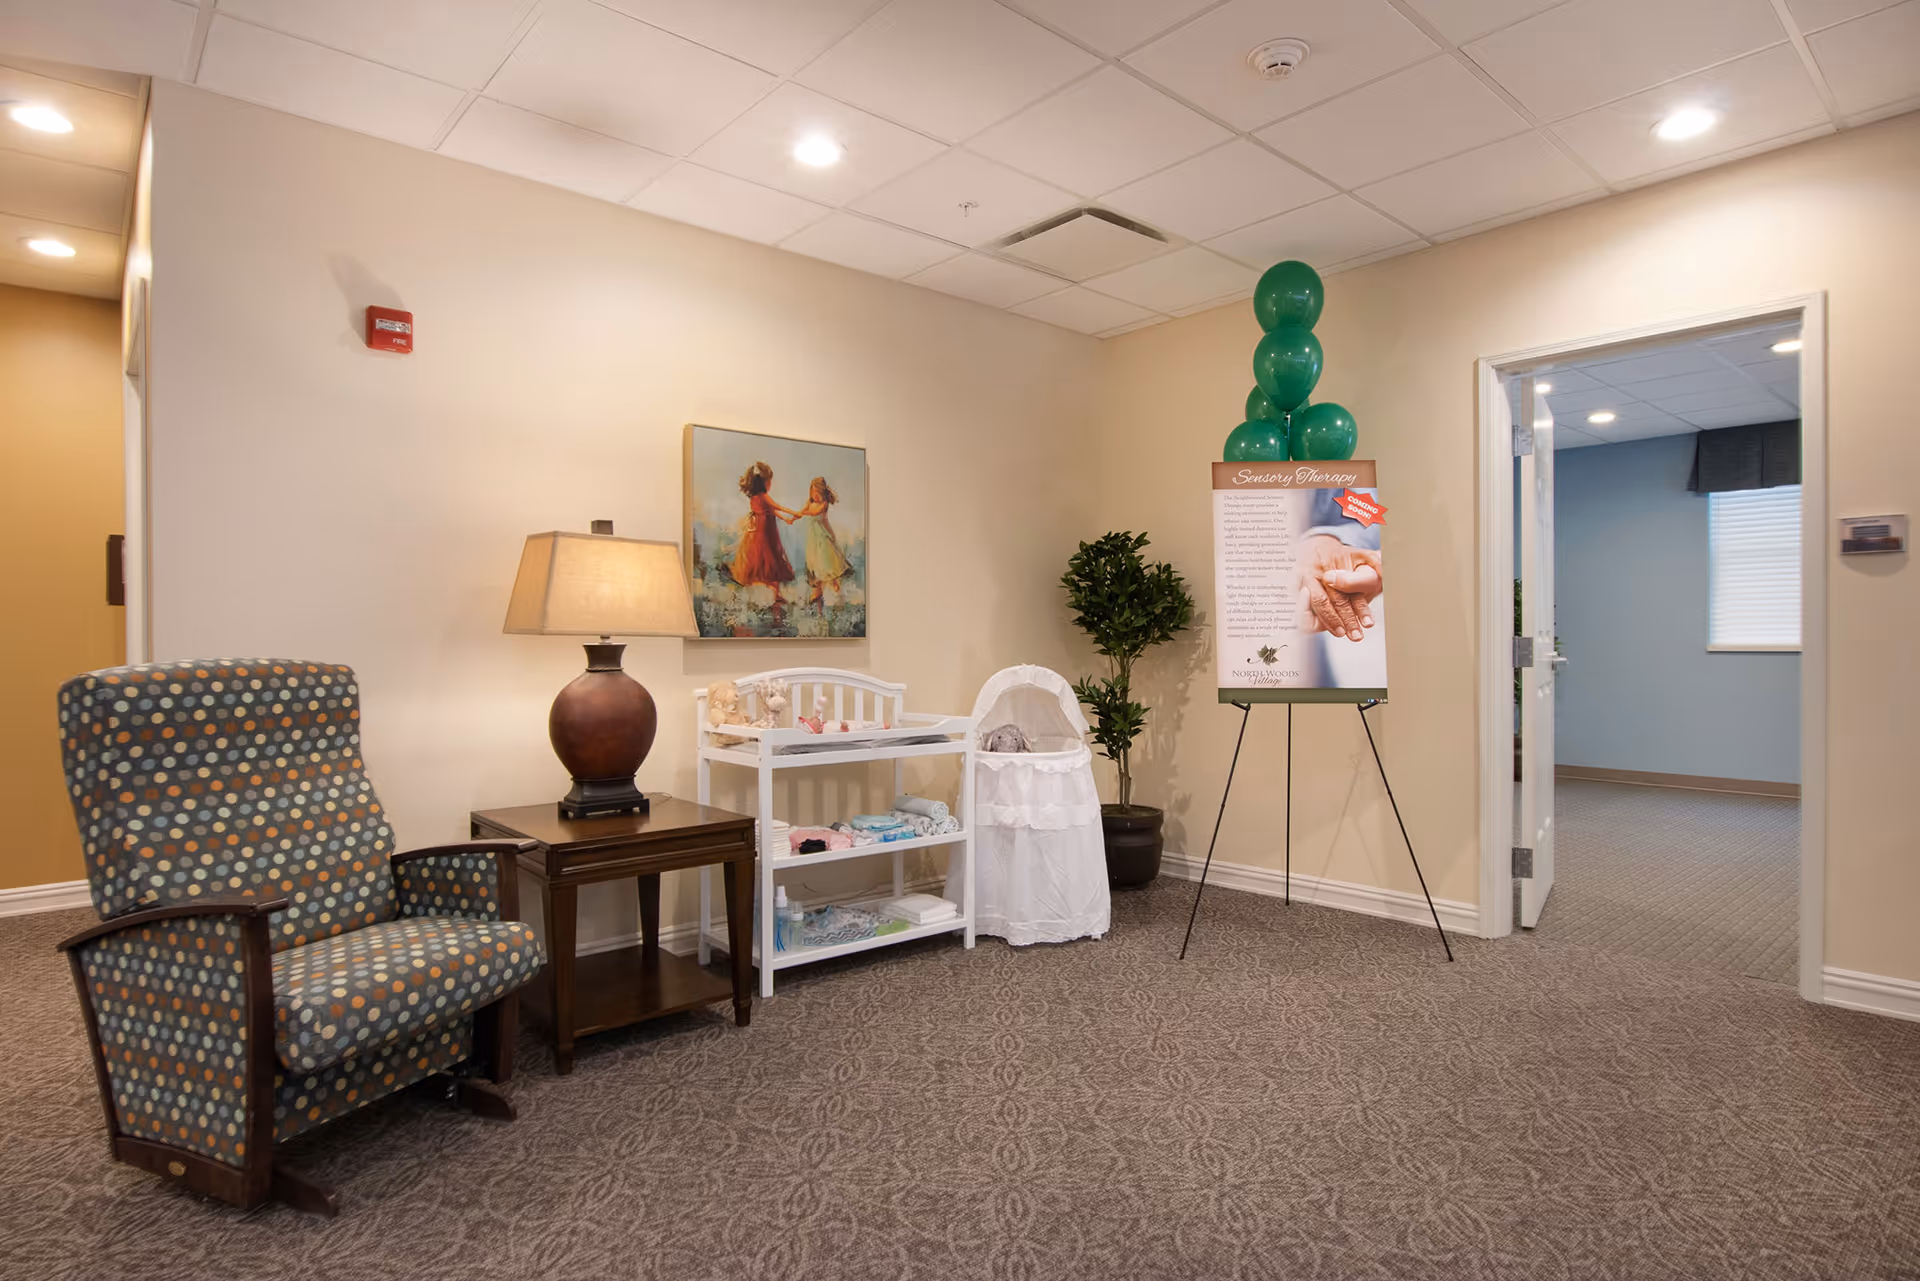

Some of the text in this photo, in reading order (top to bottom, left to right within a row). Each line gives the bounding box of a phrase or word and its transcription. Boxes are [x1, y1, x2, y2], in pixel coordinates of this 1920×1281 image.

[393, 338, 407, 346] FIRE
[1232, 467, 1357, 487] Sensory Therapy
[1347, 495, 1379, 514] COMING
[1347, 504, 1372, 520] SOON!
[1232, 670, 1300, 678] NORTH WOODS
[1248, 675, 1281, 687] Village
